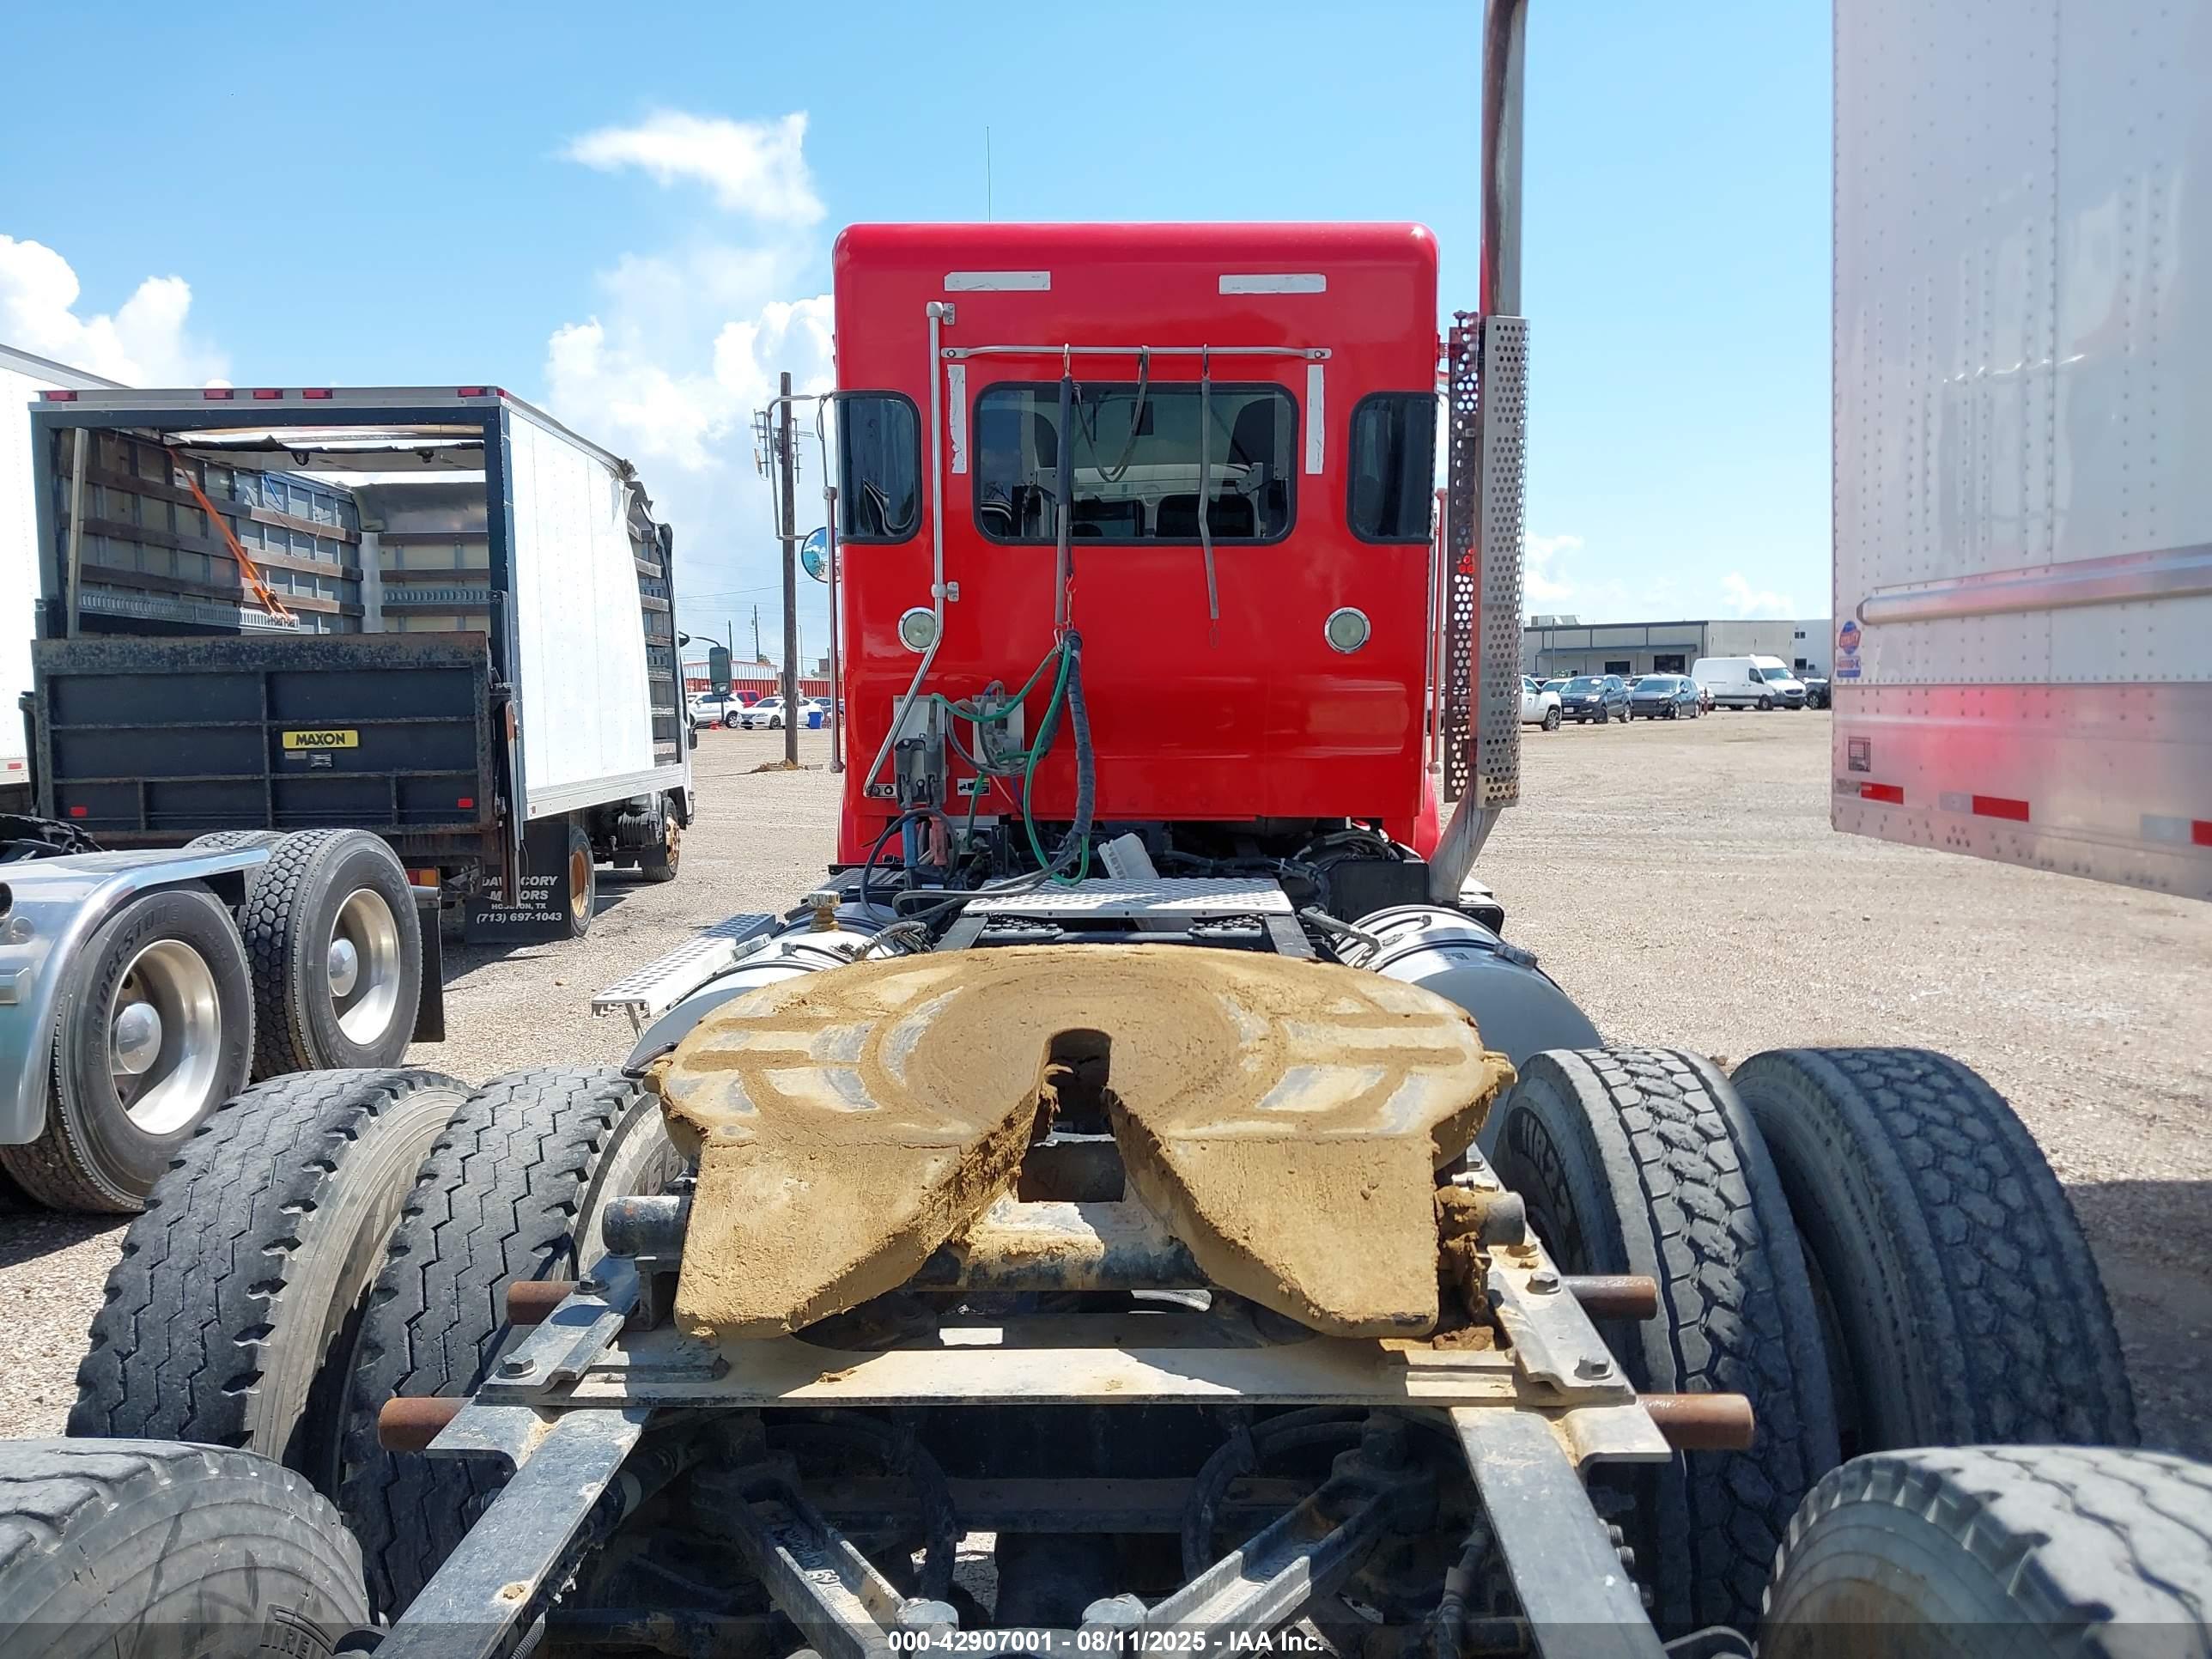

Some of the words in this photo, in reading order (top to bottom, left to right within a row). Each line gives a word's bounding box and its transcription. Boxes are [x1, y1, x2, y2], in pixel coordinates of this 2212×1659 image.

[295, 732, 345, 746] MAXON
[489, 890, 549, 901] MORS
[477, 913, 507, 925] (713)
[509, 912, 562, 921] 697-1043
[89, 902, 181, 1067] BRIDGESTONE
